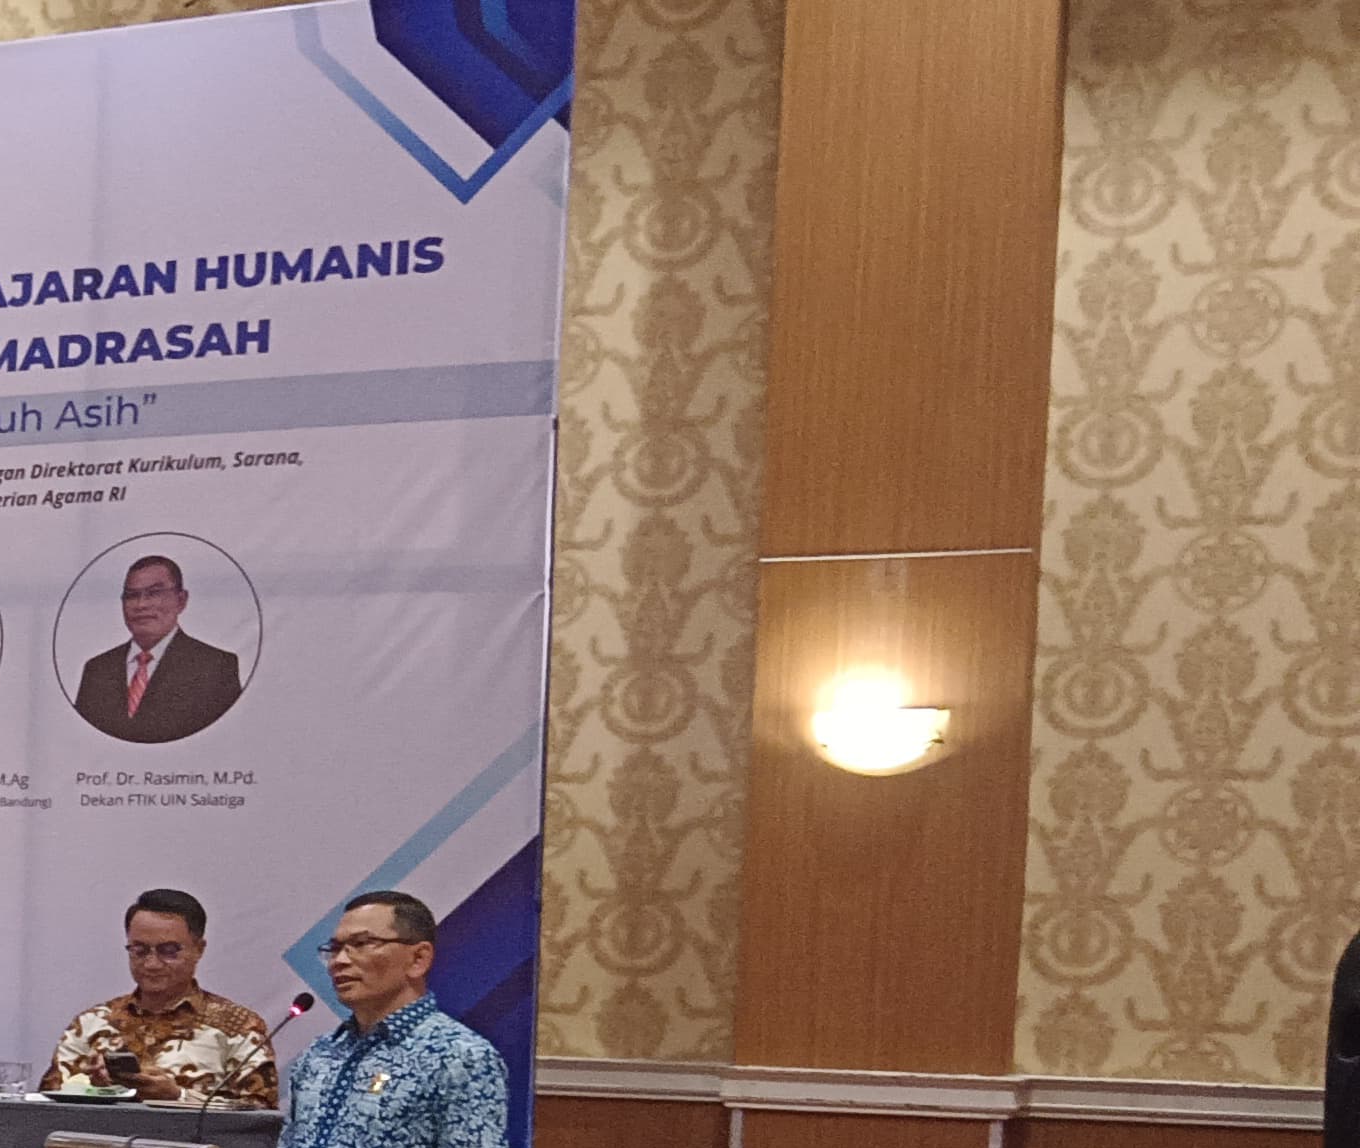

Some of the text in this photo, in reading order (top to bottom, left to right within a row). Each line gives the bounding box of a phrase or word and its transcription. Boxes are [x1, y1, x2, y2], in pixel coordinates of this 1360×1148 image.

[195, 236, 445, 291] HUMANIS
[31, 460, 123, 480] Direktorat
[128, 454, 227, 474] Kurikulum,
[233, 449, 304, 468] Sarana,
[42, 489, 104, 509] Agama
[109, 486, 128, 501] RI
[116, 771, 140, 786] Dr.
[144, 771, 208, 787] Rasimin,
[213, 770, 258, 785] M.Pd.
[80, 793, 245, 808] Dekan FTIK UIN Salatiga
